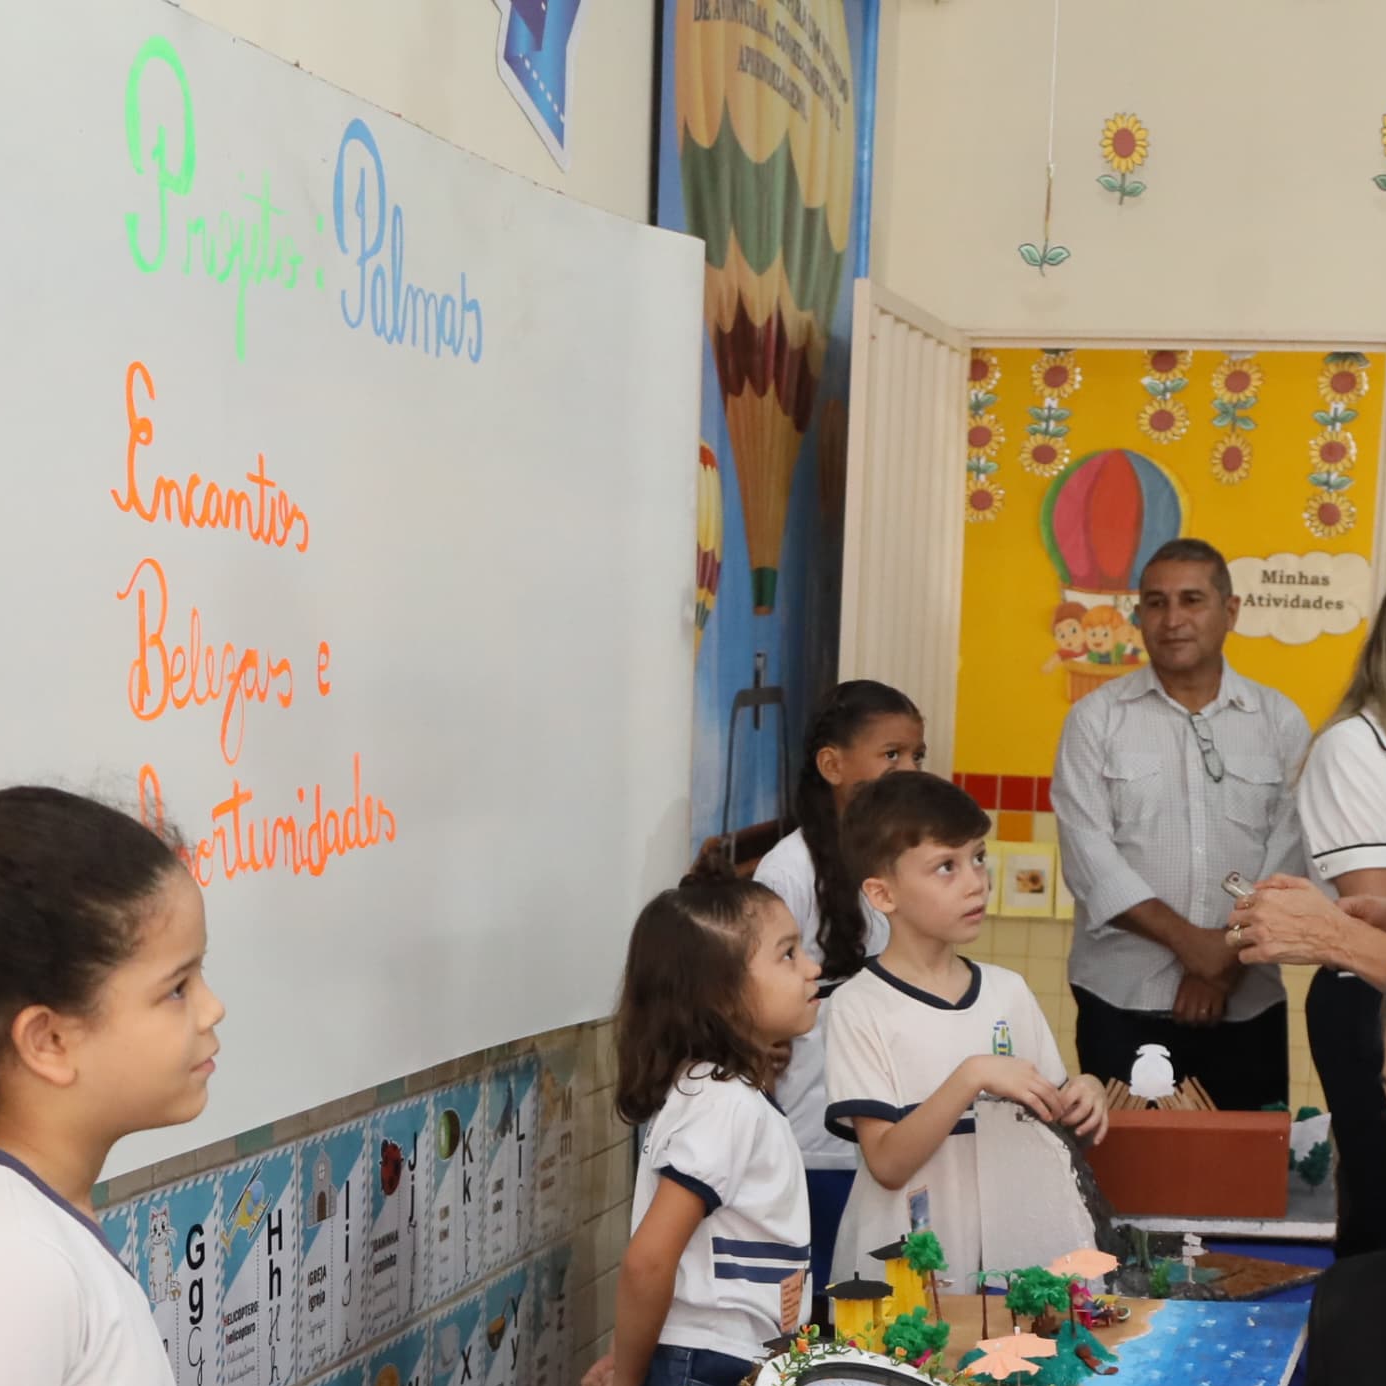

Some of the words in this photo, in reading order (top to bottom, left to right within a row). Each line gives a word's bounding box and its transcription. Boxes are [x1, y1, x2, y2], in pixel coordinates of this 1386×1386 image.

[332, 118, 484, 364] Palmas
[111, 361, 310, 553] Encantos
[1260, 569, 1331, 587] Minhas
[1242, 592, 1345, 611] Atividades
[116, 557, 294, 766] Belezas
[317, 640, 332, 697] e
[139, 752, 397, 887] Oortunidades
[462, 1127, 473, 1167] K
[516, 1108, 526, 1142] L
[408, 1131, 417, 1172] J
[185, 1223, 206, 1270] G
[266, 1208, 284, 1257] H
[188, 1277, 204, 1325] g
[268, 1258, 283, 1301] h
[460, 1344, 473, 1385] X
